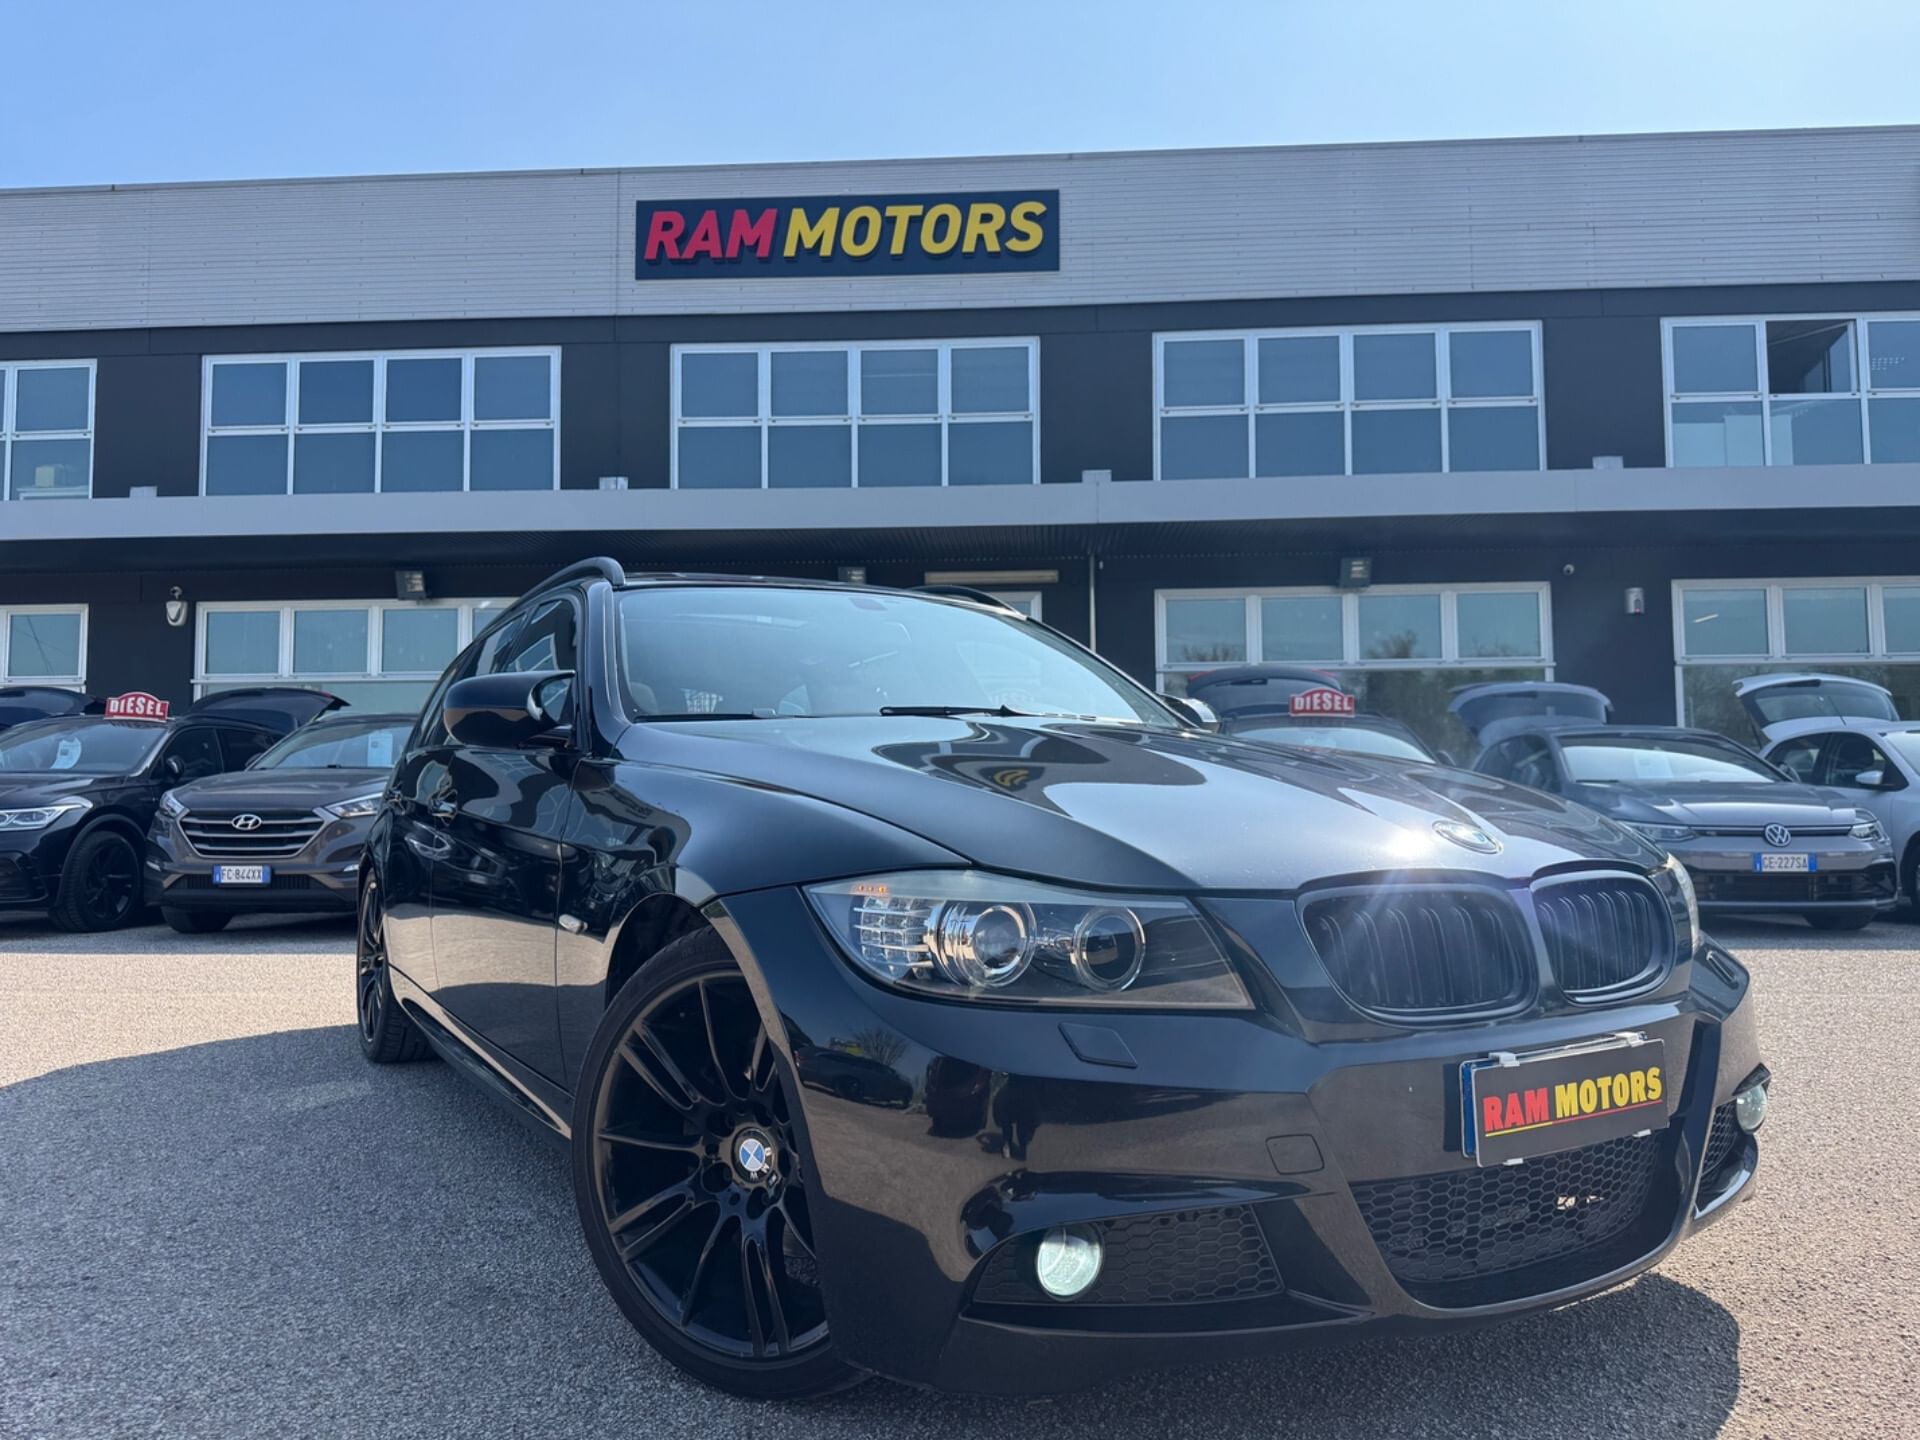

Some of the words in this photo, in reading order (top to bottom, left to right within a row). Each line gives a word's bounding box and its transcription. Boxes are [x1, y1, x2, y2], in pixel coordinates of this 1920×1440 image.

[644, 207, 777, 260] RAM
[783, 201, 1047, 257] MOTORS
[109, 697, 164, 716] DIESEL
[1294, 692, 1353, 711] DIESEL
[1482, 1087, 1549, 1132] RAM
[1554, 1067, 1663, 1119] MOTORS
